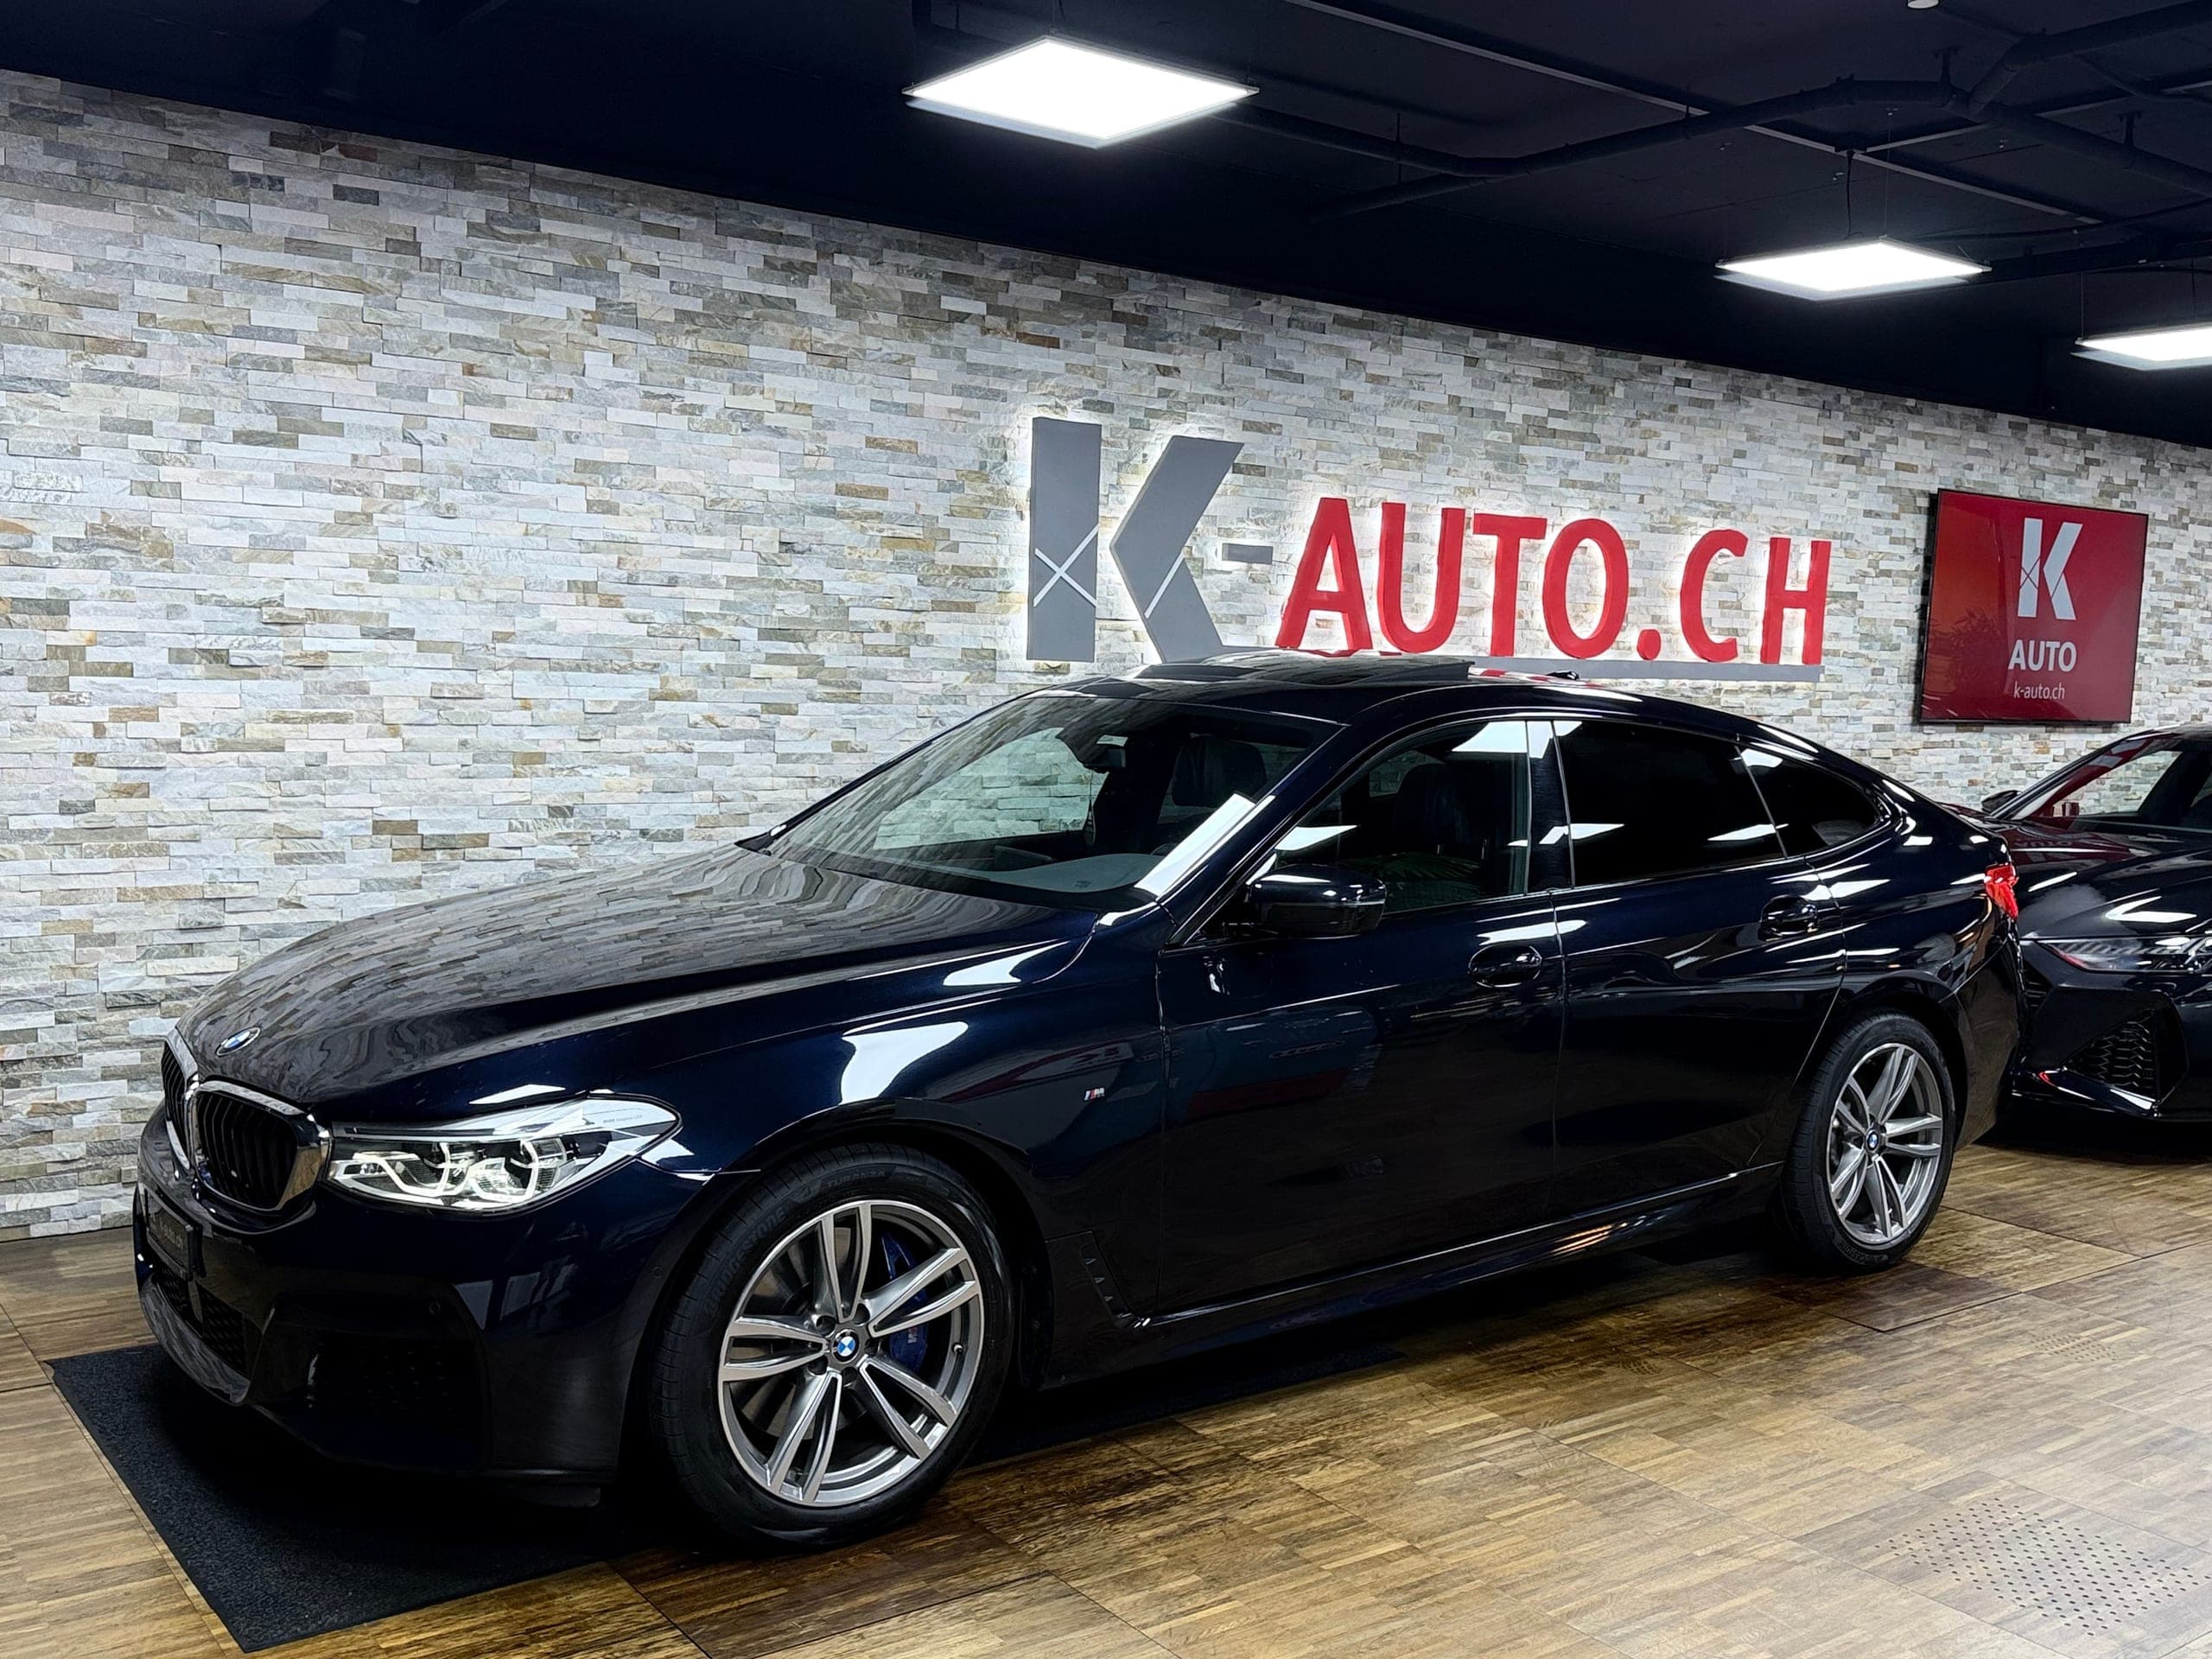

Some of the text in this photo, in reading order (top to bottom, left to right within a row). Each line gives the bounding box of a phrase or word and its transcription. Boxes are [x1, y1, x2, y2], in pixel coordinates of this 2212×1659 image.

[1027, 416, 1832, 664] K-AUTO.CH
[2018, 517, 2084, 620] K
[2008, 639, 2077, 672] AUTO
[2013, 681, 2065, 700] k-auto.ch
